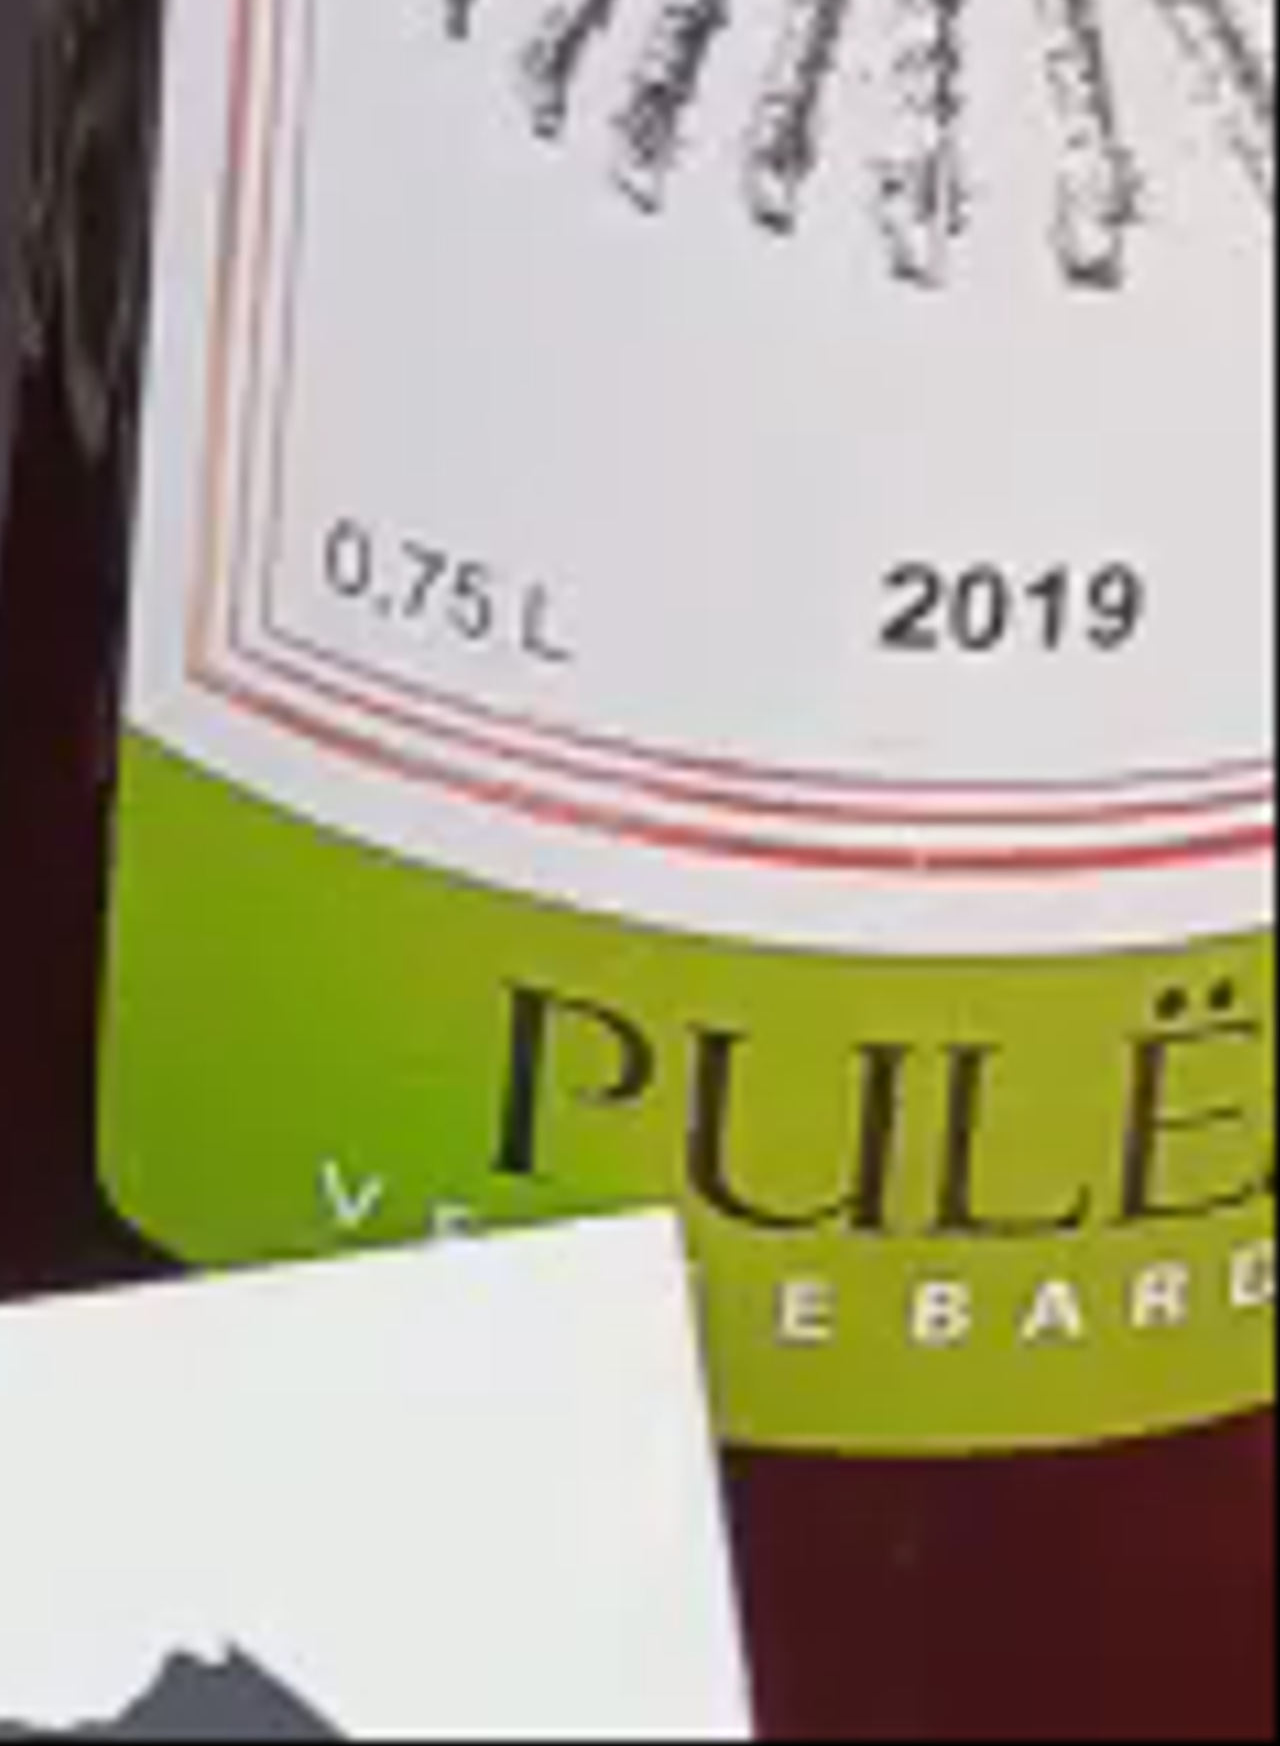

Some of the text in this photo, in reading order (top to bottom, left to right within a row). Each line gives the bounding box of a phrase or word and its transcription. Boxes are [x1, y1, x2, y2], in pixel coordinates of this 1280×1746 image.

[518, 582, 575, 662] L
[876, 561, 1146, 652] 2019
[492, 976, 1276, 1240] PULË
